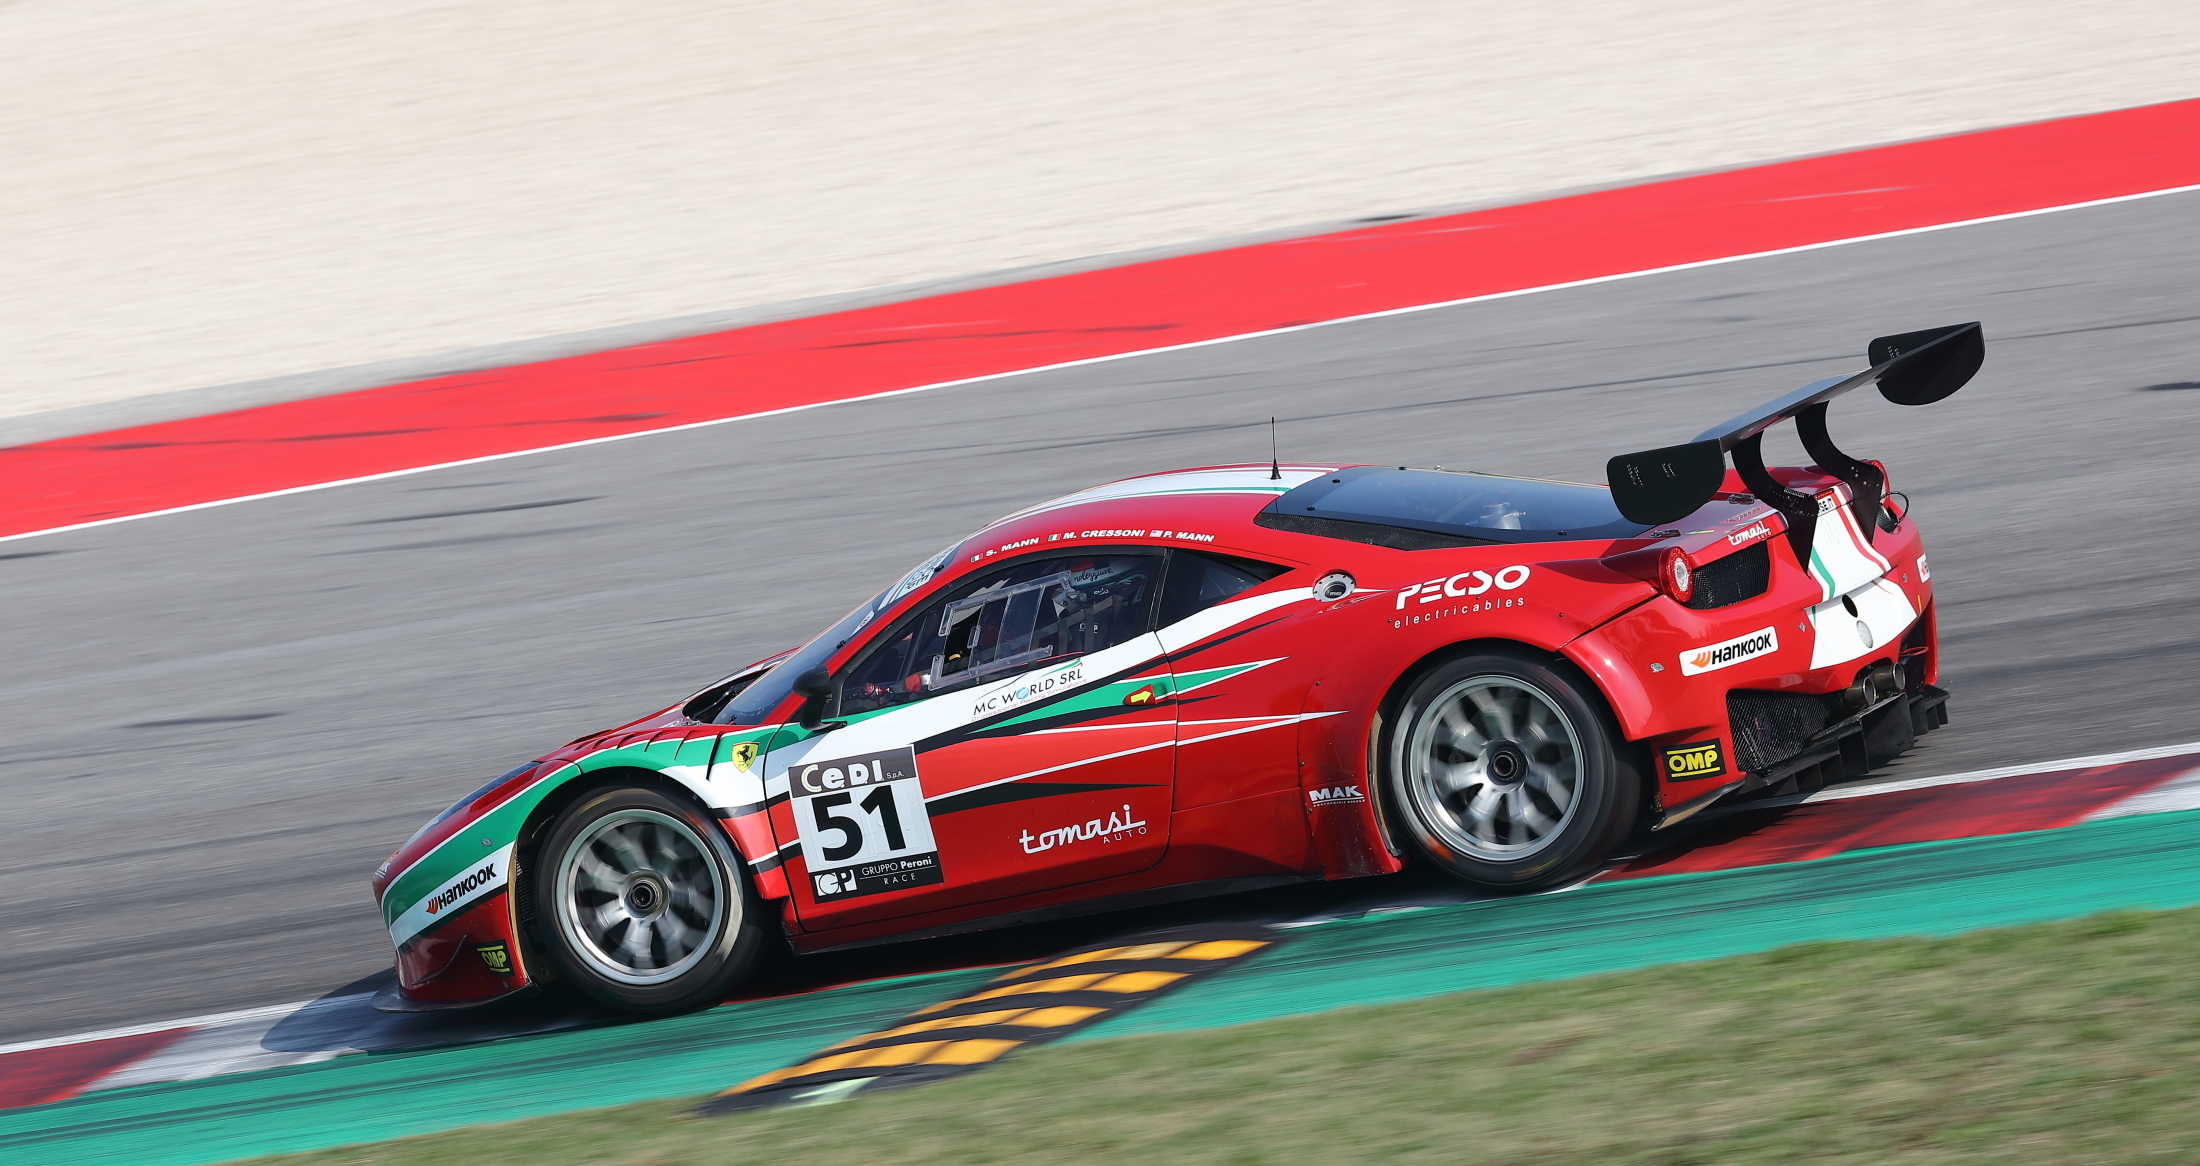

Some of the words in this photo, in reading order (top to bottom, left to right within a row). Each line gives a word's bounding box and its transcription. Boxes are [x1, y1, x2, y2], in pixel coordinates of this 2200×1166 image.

[1063, 531, 1077, 540] M.
[1080, 530, 1146, 538] CRESSONI
[1162, 530, 1173, 538] P.
[1175, 532, 1215, 543] MANN
[1728, 520, 1770, 546] tomasi
[1757, 531, 1772, 540] AUTO
[985, 549, 998, 557] S.
[1001, 537, 1040, 552] MANN
[1395, 564, 1531, 611] PECSO
[1394, 596, 1525, 629] electricables
[971, 703, 1019, 722] Professional
[1020, 694, 1046, 706] Racing
[1047, 679, 1088, 697] Simulators
[973, 698, 997, 716] MC
[1002, 678, 1055, 704] WORLD
[1059, 668, 1083, 685] SRL
[1669, 750, 1718, 772] OMP
[1308, 785, 1364, 802] MAK
[810, 785, 907, 862] 51
[1018, 803, 1146, 854] tomasi
[1103, 826, 1147, 844] AUTO
[861, 862, 898, 876] GRUPPO
[900, 856, 932, 870] Peroni
[883, 873, 917, 885] RACE
[481, 950, 507, 968] OMP
